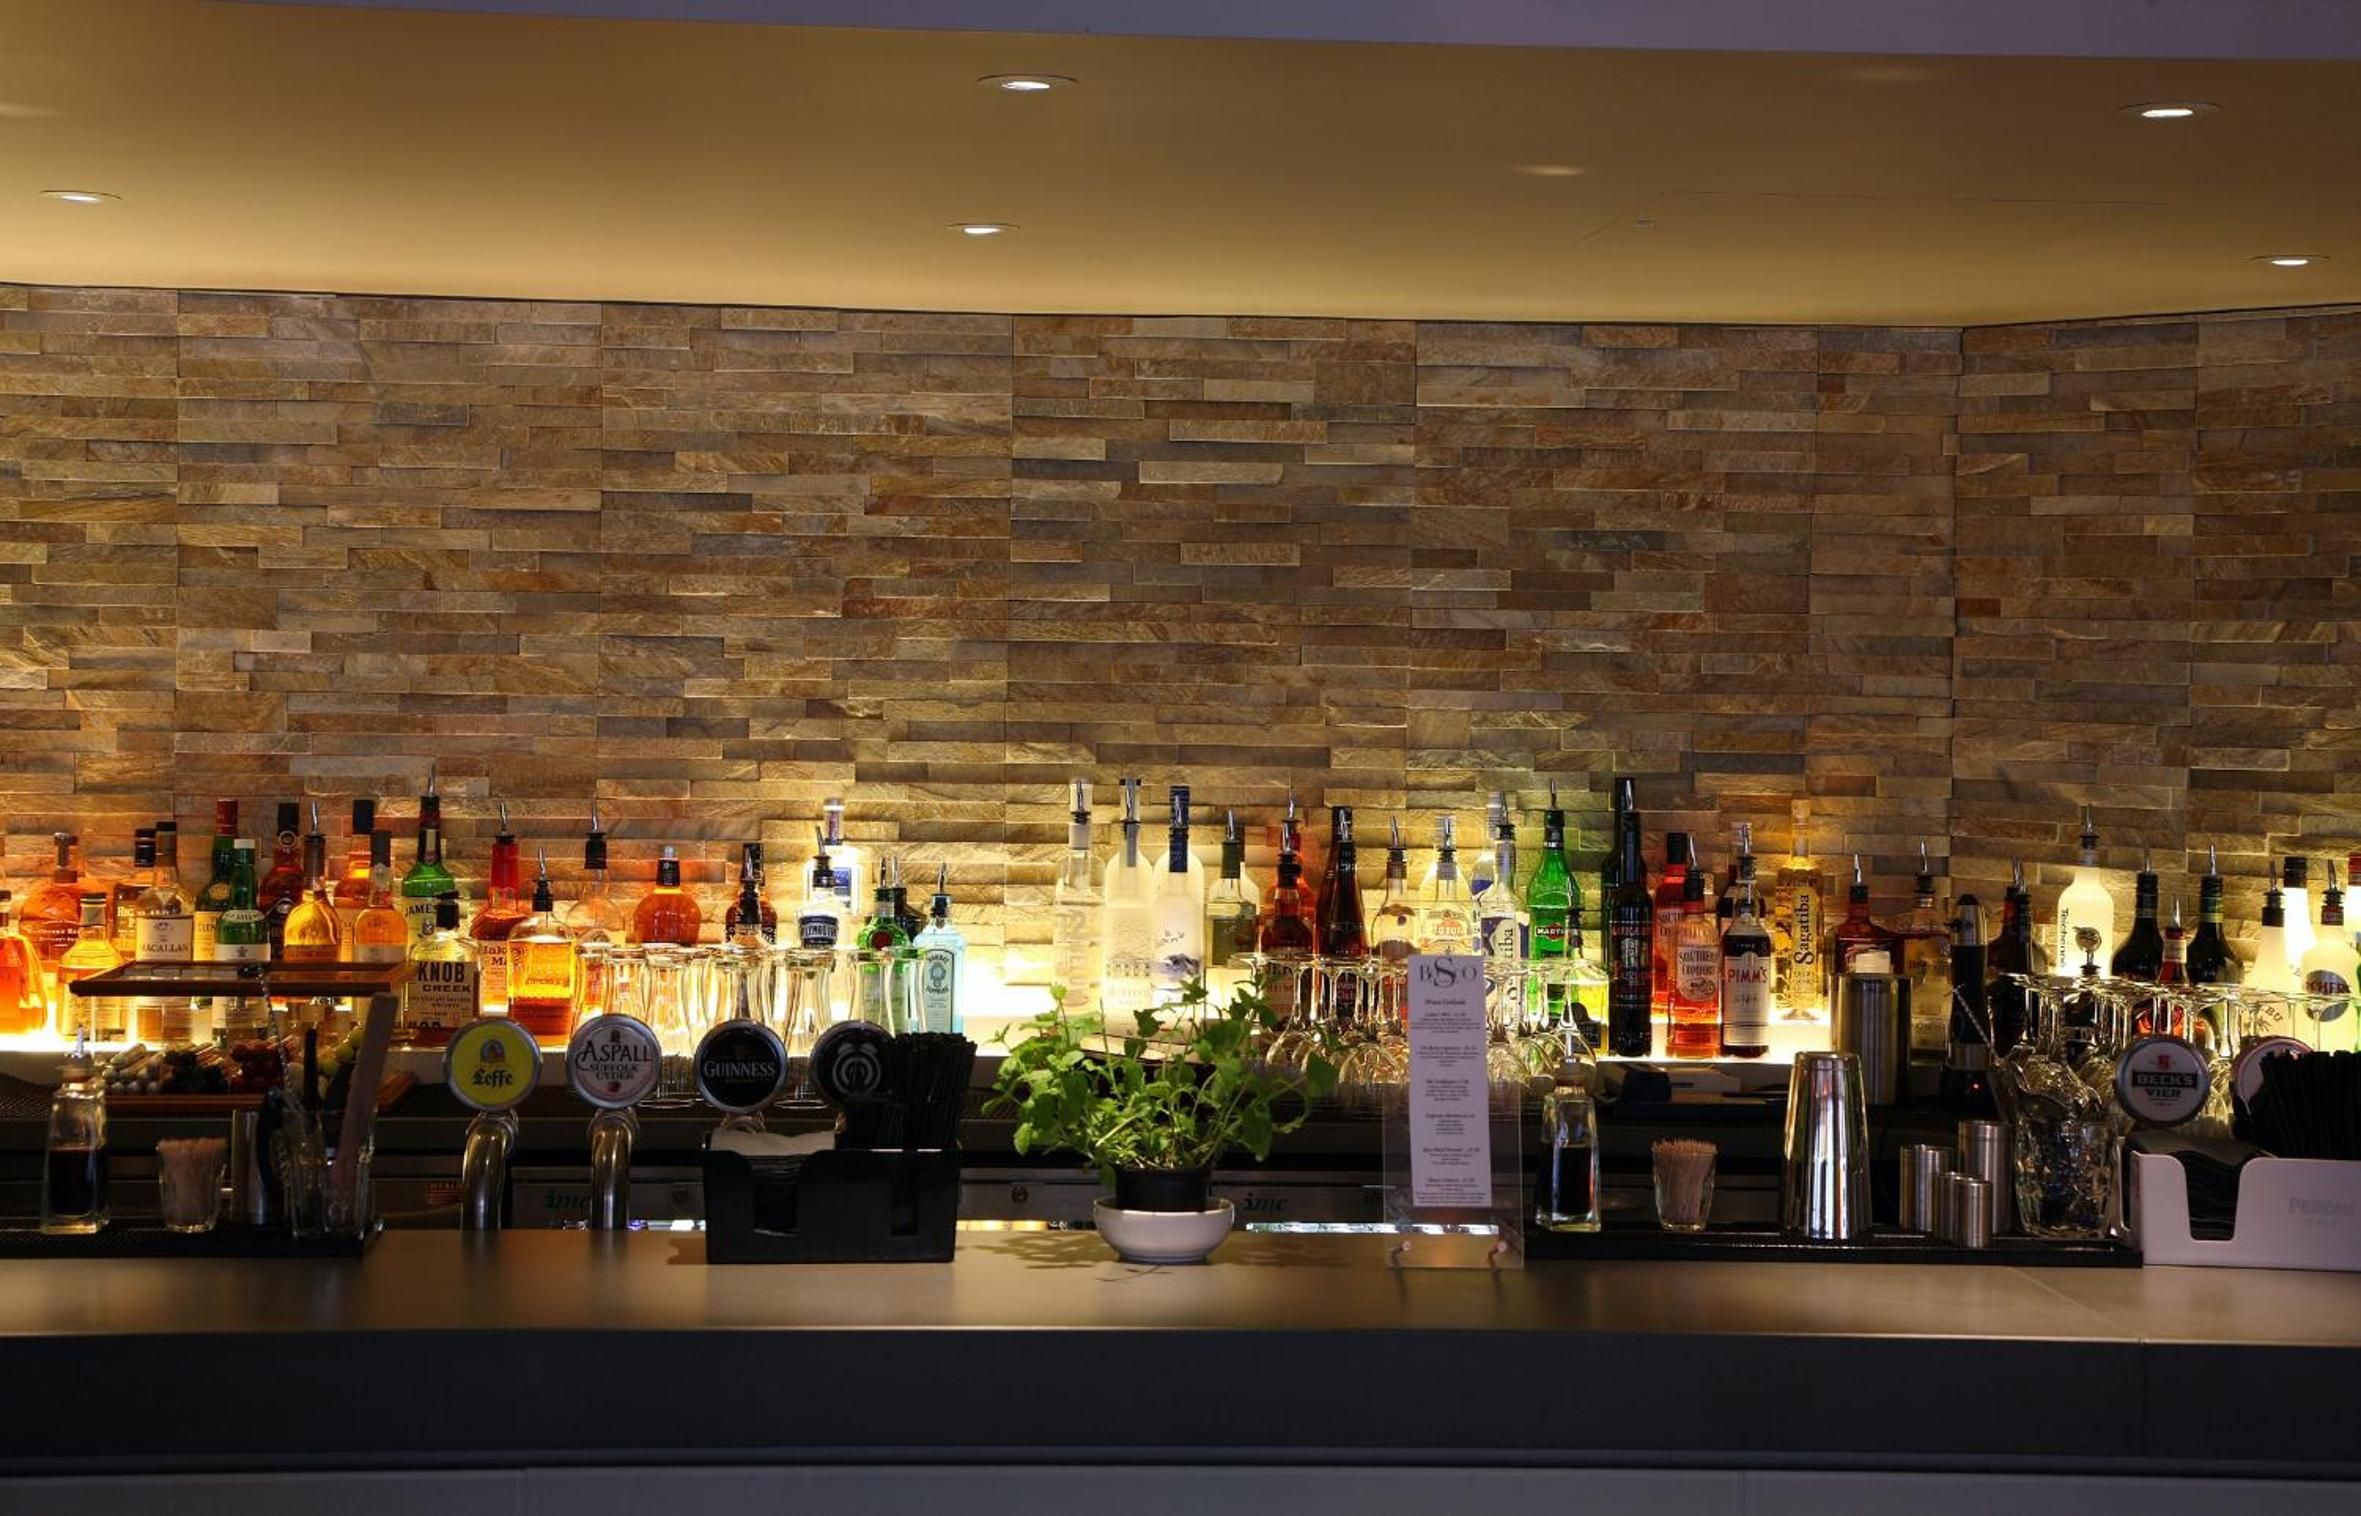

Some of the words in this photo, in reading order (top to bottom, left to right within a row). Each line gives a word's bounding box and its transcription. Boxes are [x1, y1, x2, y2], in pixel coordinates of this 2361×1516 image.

[1794, 895, 1814, 965] Sagatiba
[416, 962, 465, 982] KNOB
[1727, 966, 1768, 984] PIMM'S
[423, 985, 471, 993] CREEK
[576, 1040, 653, 1070] ASPALL
[473, 1068, 513, 1086] Leffe
[703, 1060, 776, 1078] GUINNESS
[2144, 1088, 2182, 1098] VIER
